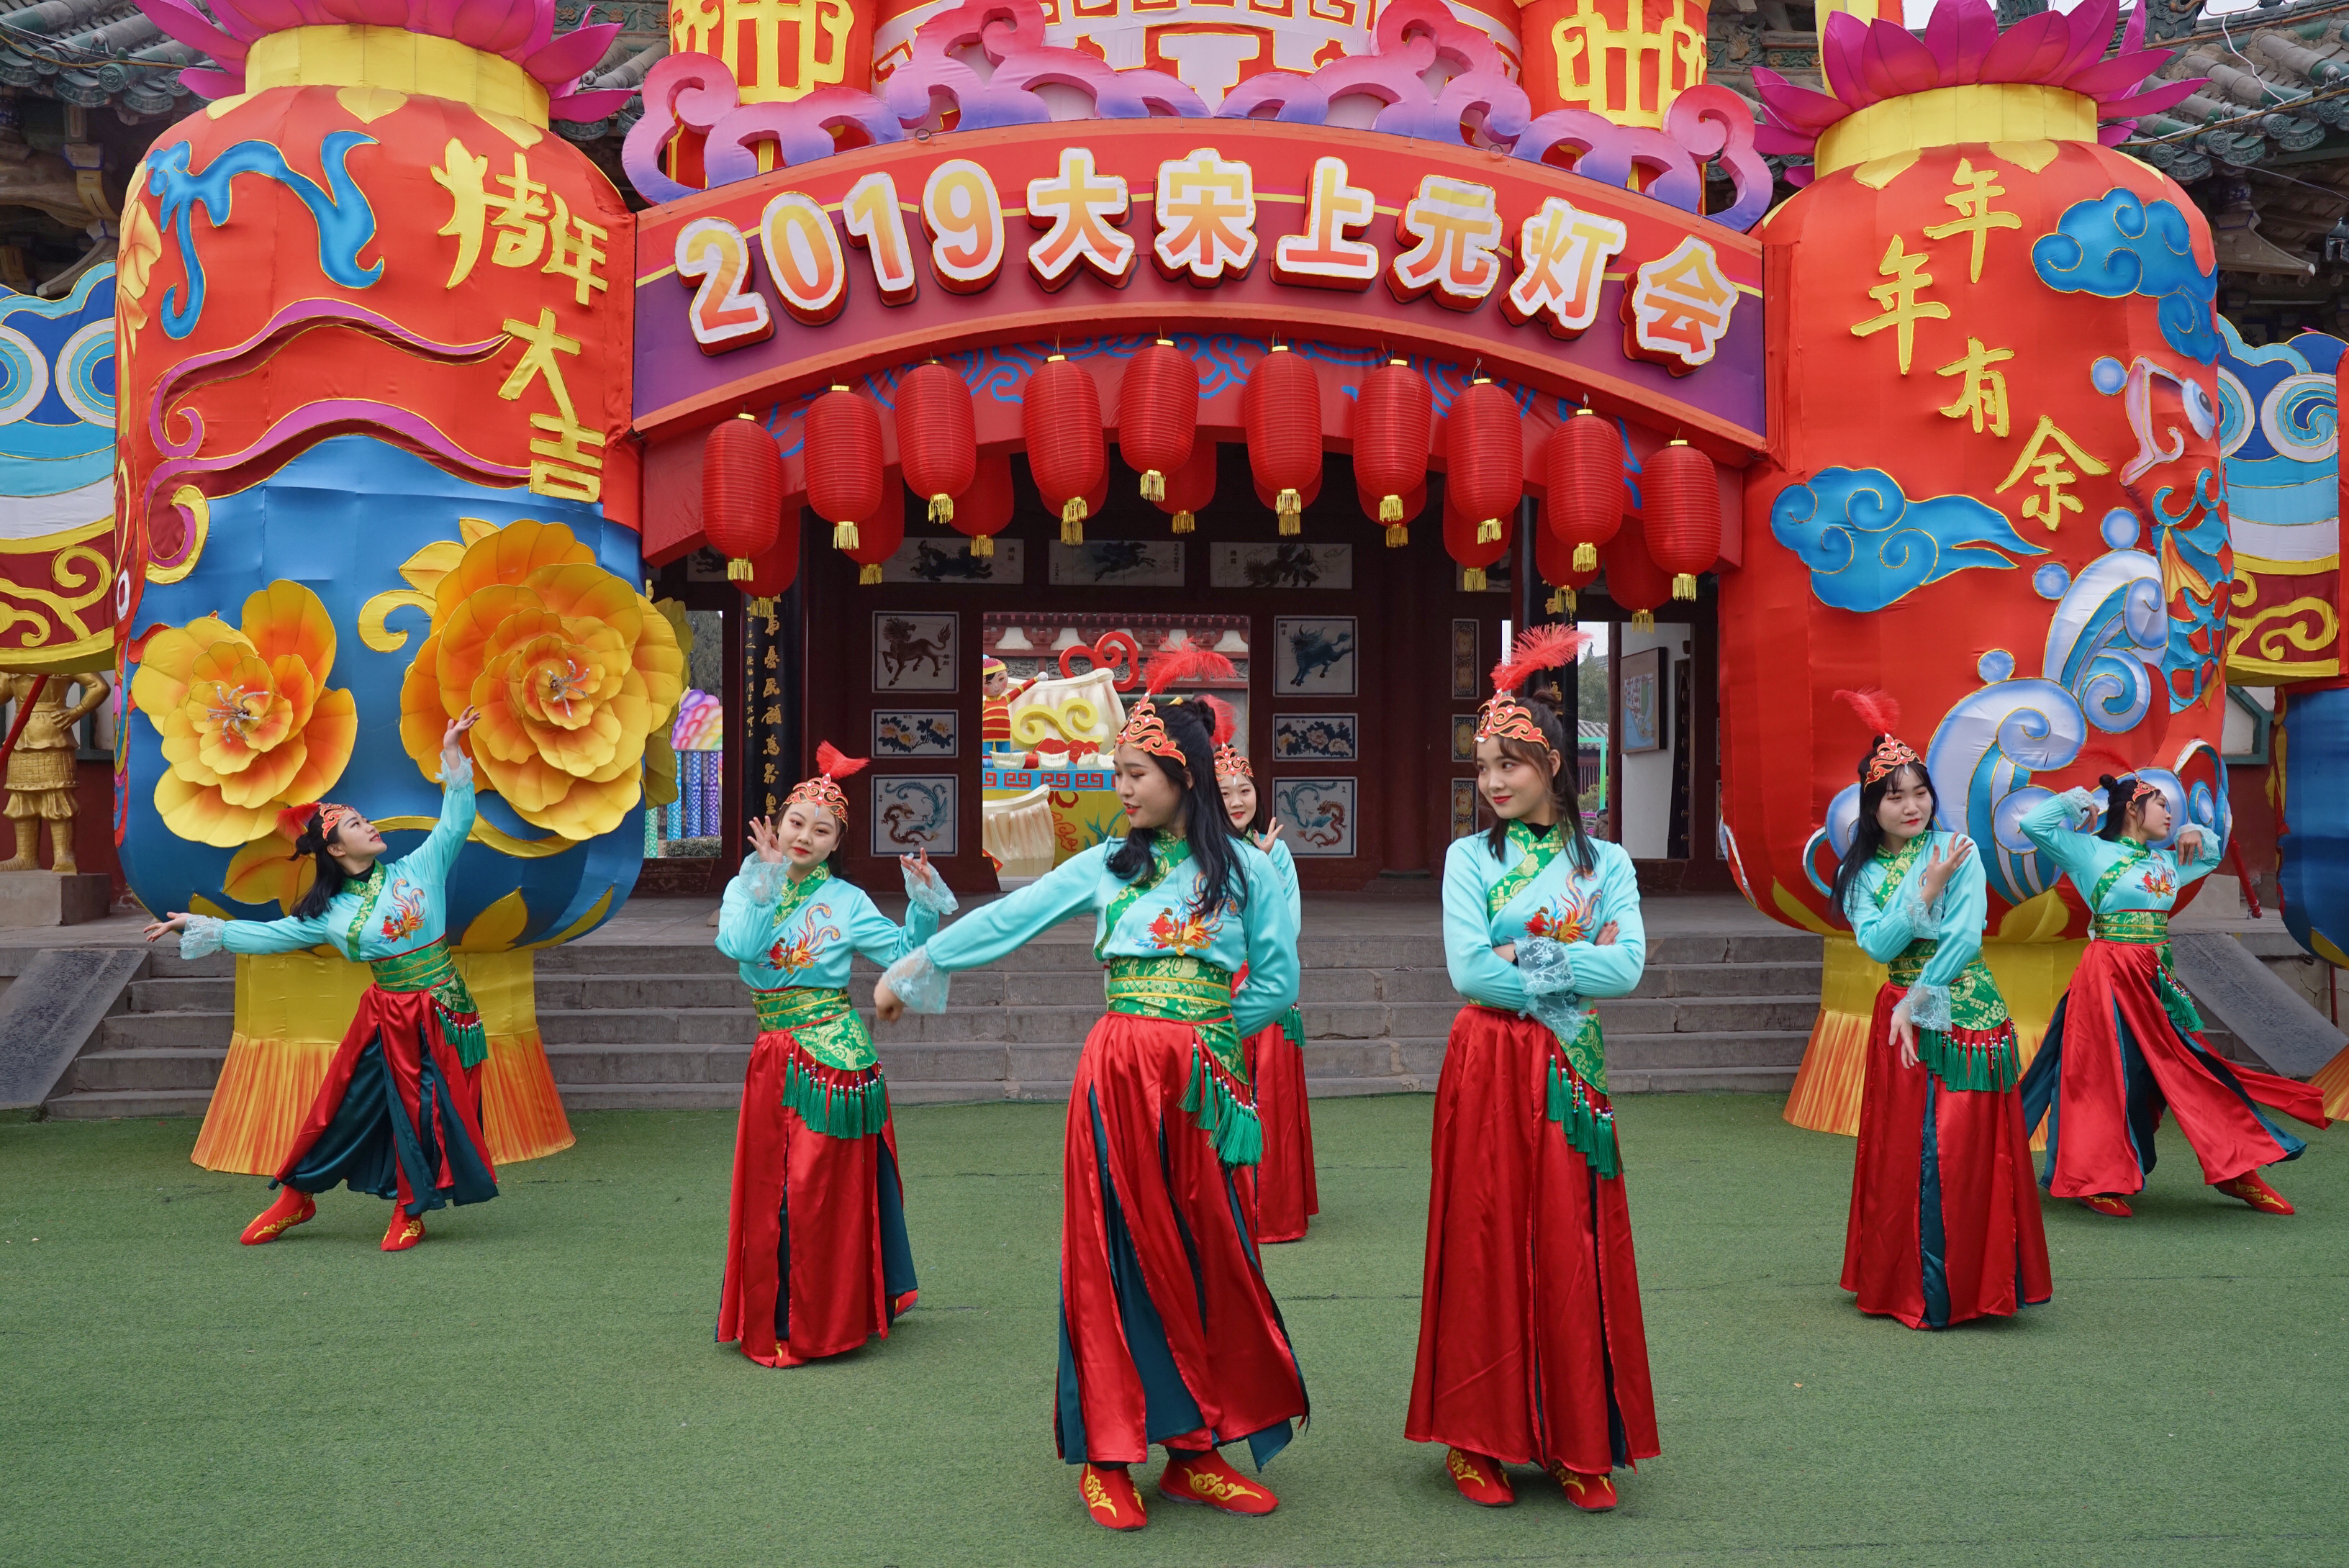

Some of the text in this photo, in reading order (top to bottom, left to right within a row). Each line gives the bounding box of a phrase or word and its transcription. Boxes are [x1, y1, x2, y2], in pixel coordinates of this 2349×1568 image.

[674, 147, 1739, 376] 2019大宋上元灯会
[1851, 158, 2111, 531] 年年有余
